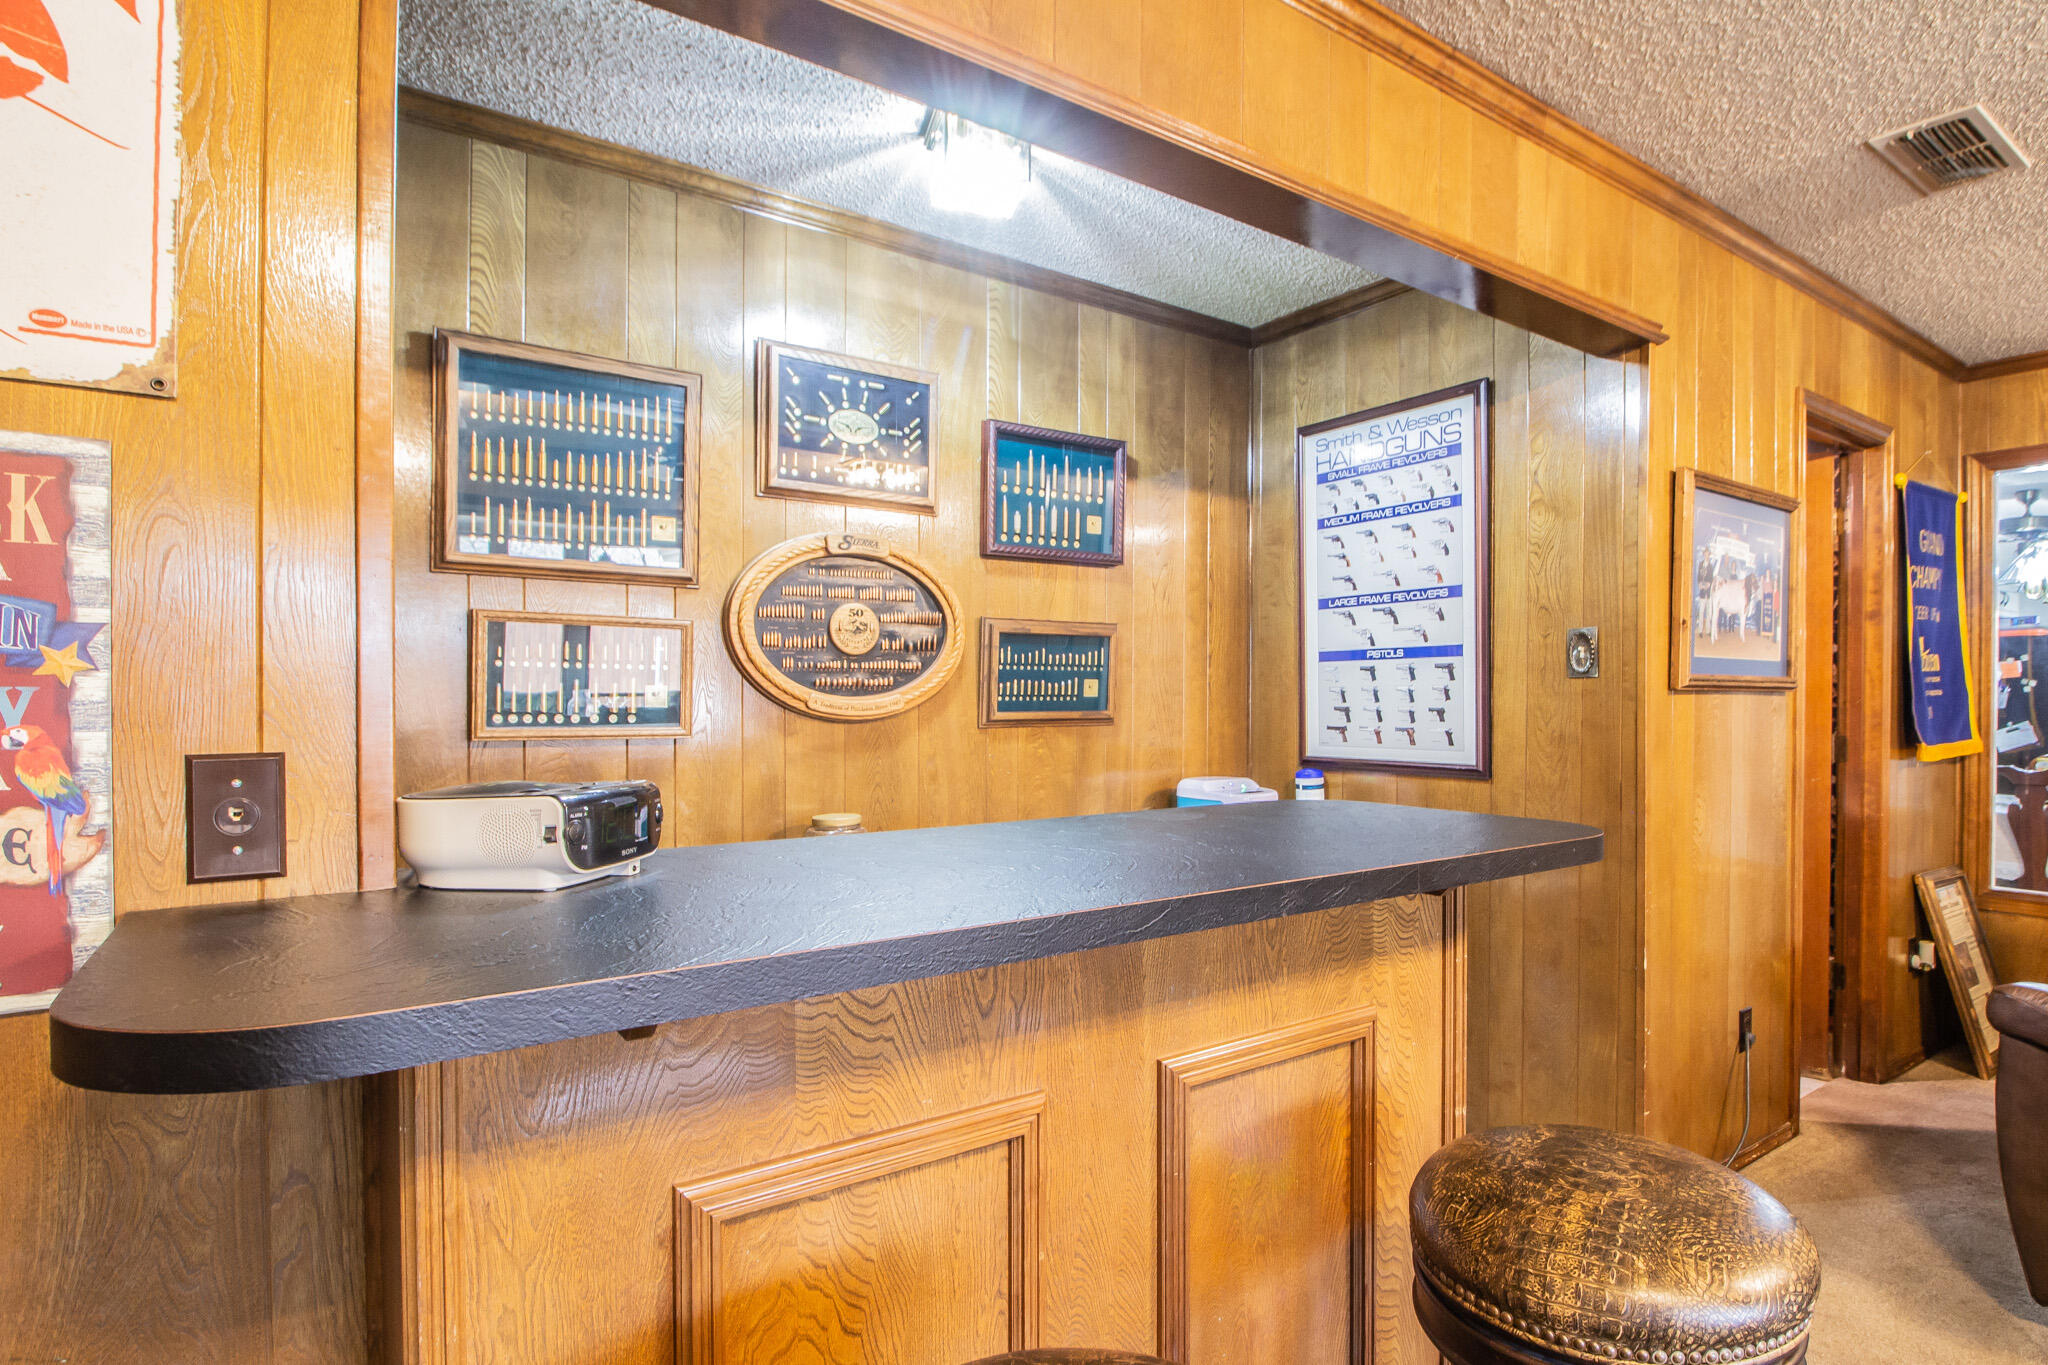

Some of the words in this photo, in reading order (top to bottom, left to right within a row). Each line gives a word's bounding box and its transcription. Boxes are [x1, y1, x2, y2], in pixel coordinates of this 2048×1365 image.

[70, 319, 92, 330] Made
[94, 322, 101, 331] in
[102, 324, 115, 332] the
[116, 325, 134, 335] USA
[1315, 430, 1362, 453] Smith
[1368, 424, 1383, 440] &
[1386, 407, 1462, 435] Wesson
[1327, 469, 1357, 481] SMALL
[1358, 461, 1391, 474] FRAME
[1392, 447, 1448, 467] REVOLVERS
[1324, 514, 1360, 527] MEDIUM
[1361, 508, 1394, 521] FRAME
[1394, 496, 1451, 515] REVOLVERS
[1328, 597, 1358, 608] LARGE
[1359, 594, 1392, 605] FRAME
[1393, 588, 1449, 602] REVOLVERS
[848, 608, 864, 618] 50
[1366, 648, 1404, 659] PISTOLS
[621, 846, 638, 857] SONY
